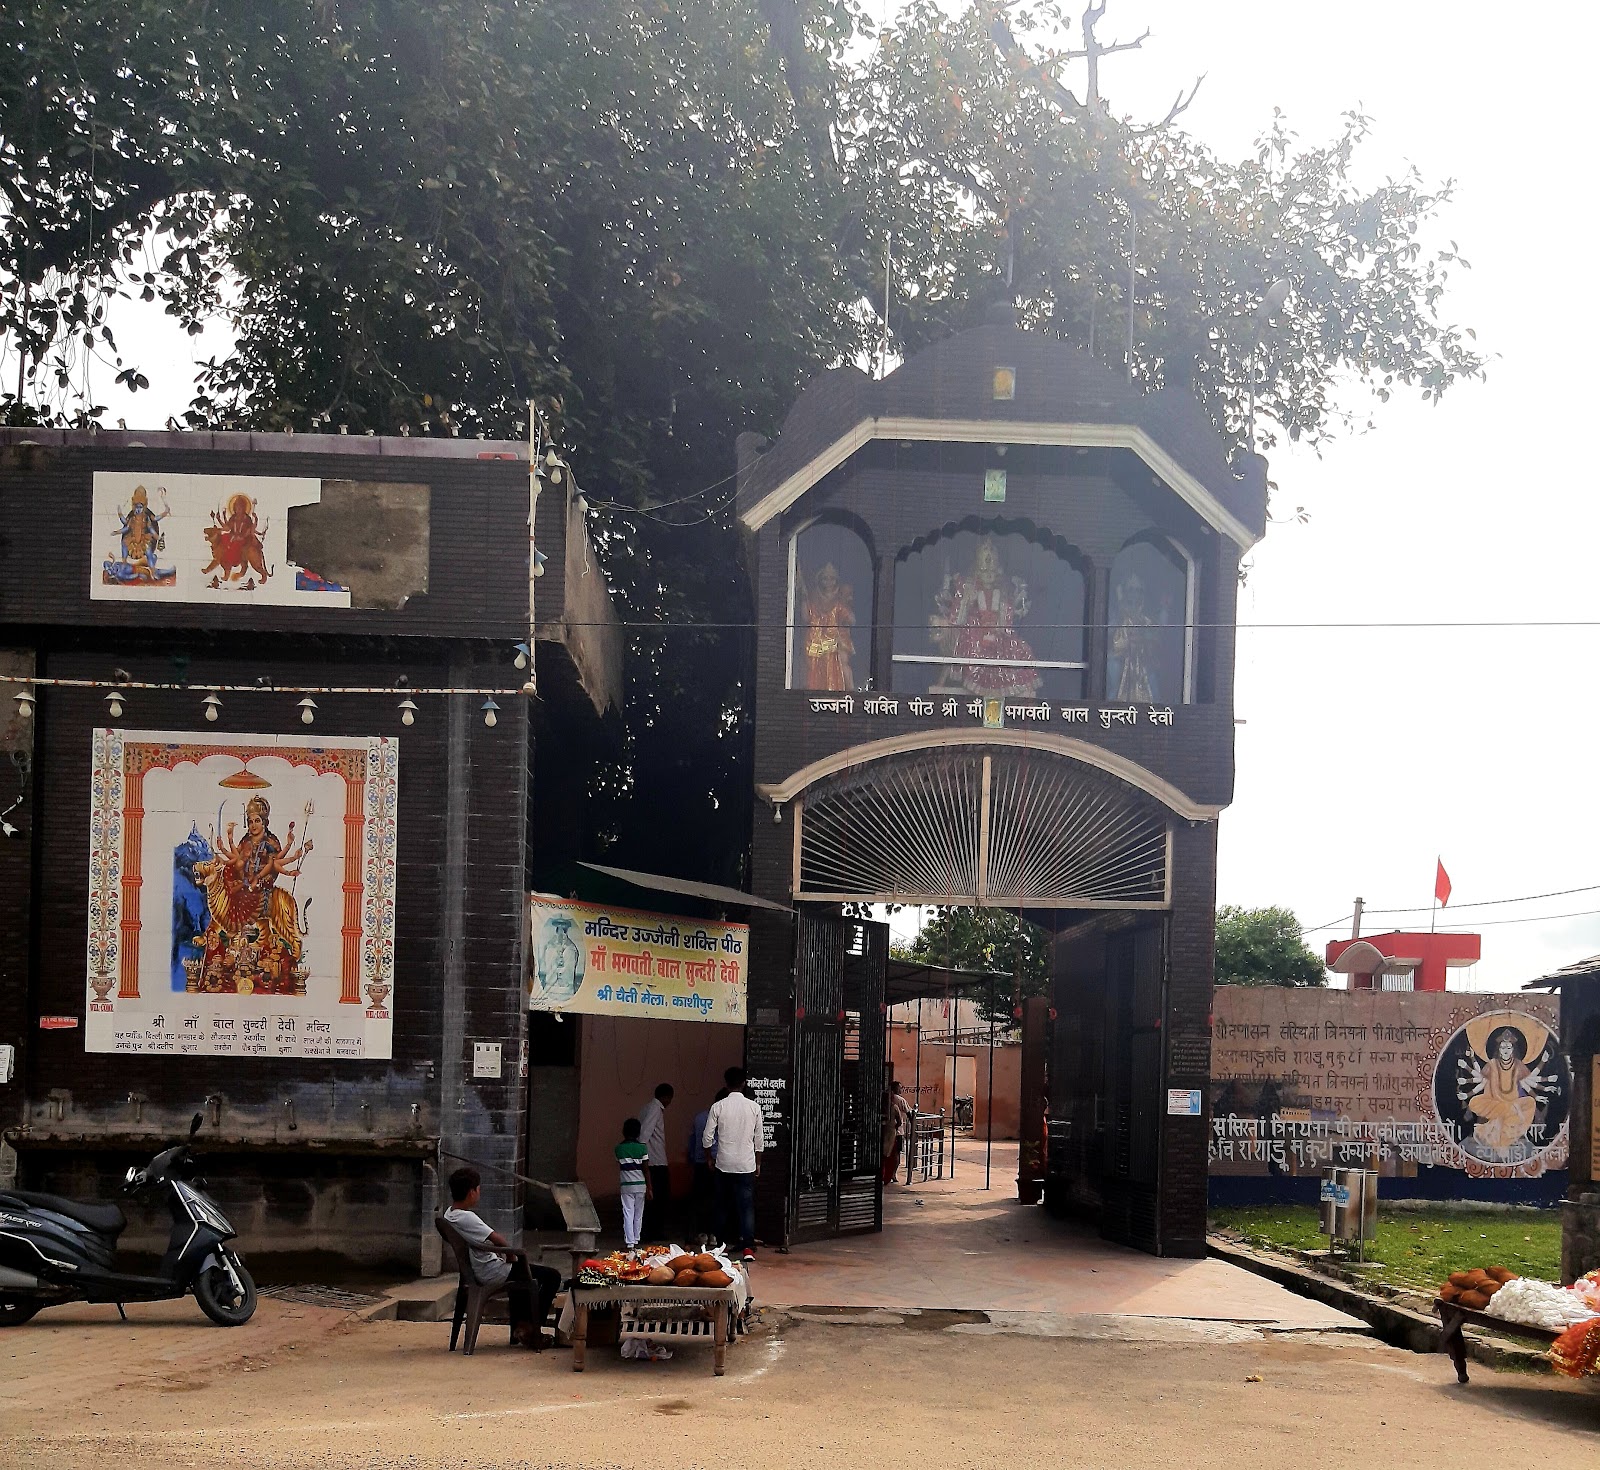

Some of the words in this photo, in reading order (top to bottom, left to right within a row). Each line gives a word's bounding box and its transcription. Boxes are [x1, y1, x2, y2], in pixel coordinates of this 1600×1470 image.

[863, 696, 898, 716] शक्ति
[908, 697, 934, 717] पीठ
[942, 696, 958, 717] श्री
[966, 697, 983, 718] माँ
[1005, 697, 1051, 722] भगवती
[1061, 706, 1090, 723] बाल
[1100, 701, 1138, 729] सुन्दरी
[1149, 704, 1174, 726] देवी
[585, 916, 629, 942] मन्दिर
[631, 924, 680, 948] उज्जैनी
[683, 930, 718, 952] शक्ति
[721, 933, 743, 955] पीठ
[590, 945, 607, 972] माँ
[612, 950, 653, 976] भगवती
[656, 957, 682, 980] बाल
[685, 957, 718, 987] सुन्दरी
[720, 959, 740, 985] देवी
[597, 984, 613, 1001] श्री
[615, 984, 638, 1004] चैती
[671, 992, 714, 1016] काशीपुर
[152, 1014, 166, 1029] श्री
[184, 1014, 200, 1030] माँ
[212, 1018, 234, 1030] बाल
[242, 1016, 267, 1034] सुन्दरी
[277, 1017, 296, 1032] देवी
[306, 1019, 331, 1034] मन्दिर
